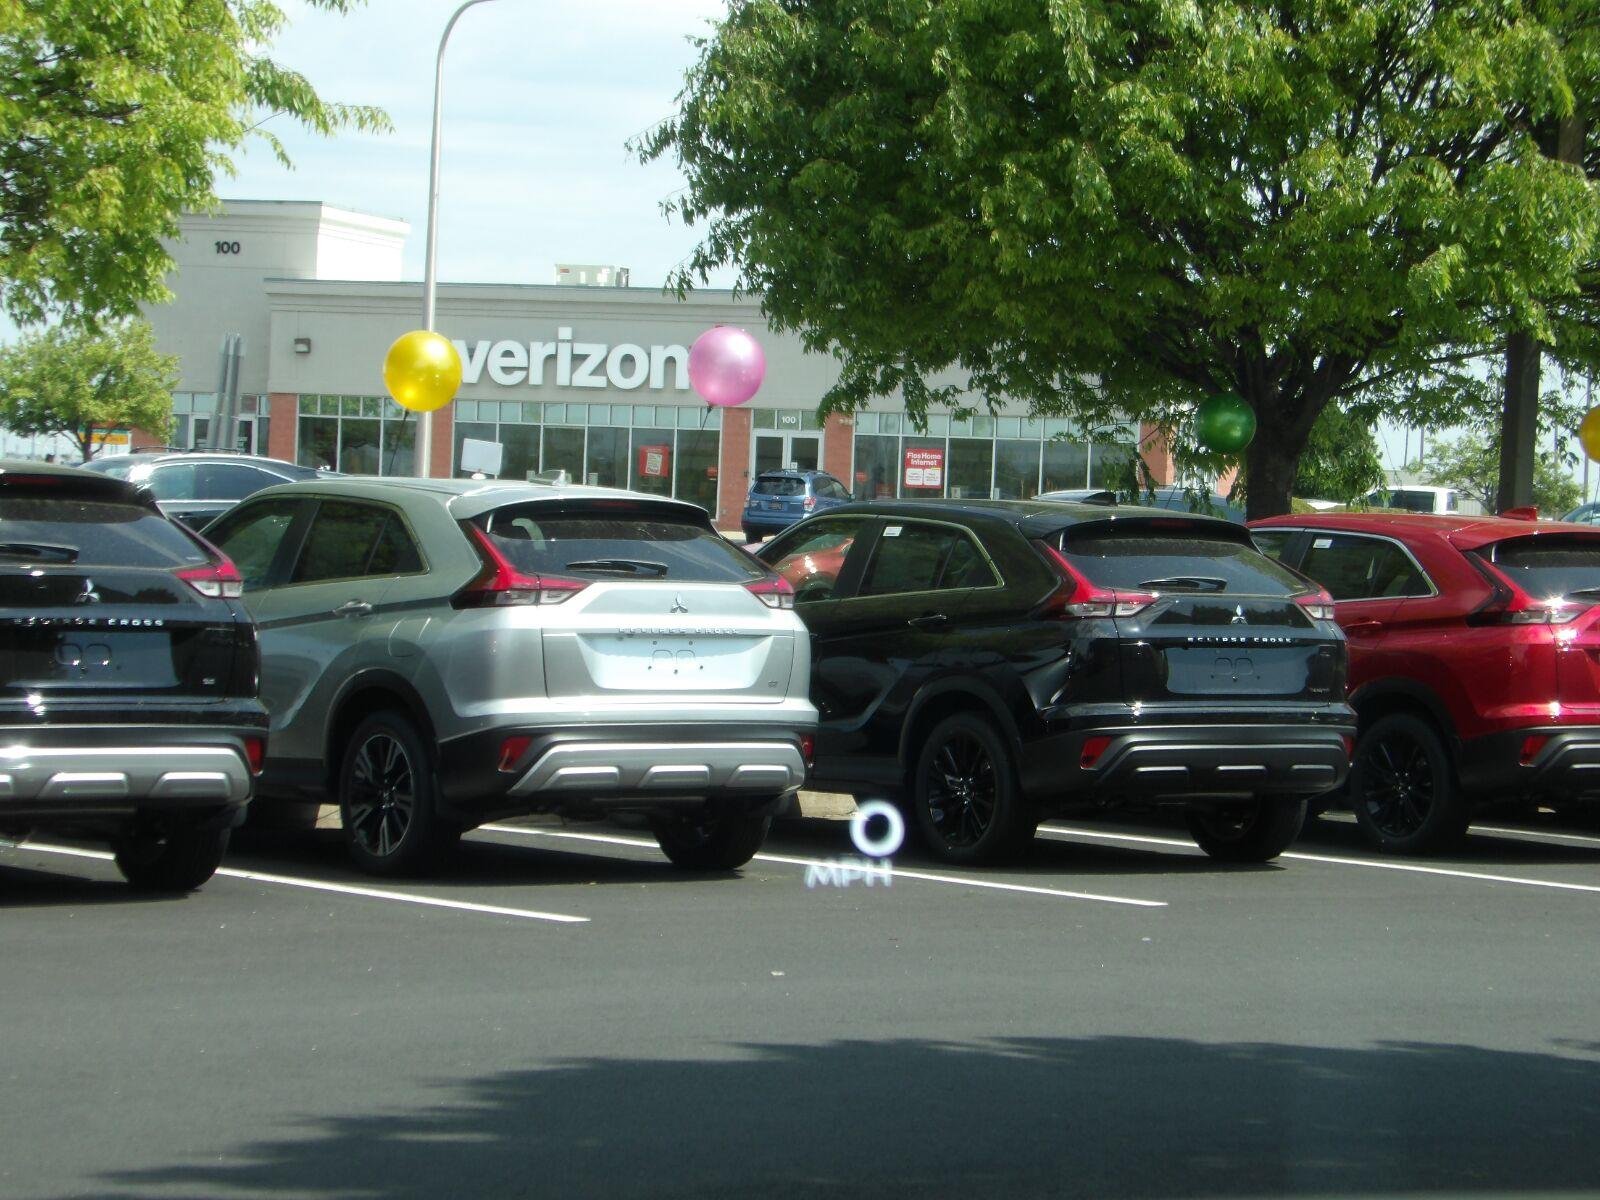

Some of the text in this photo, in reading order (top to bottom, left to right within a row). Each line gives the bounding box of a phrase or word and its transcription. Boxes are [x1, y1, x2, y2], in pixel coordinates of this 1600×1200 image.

[215, 241, 240, 254] 100
[452, 327, 690, 390] verizon
[782, 416, 796, 424] 100
[803, 858, 893, 888] MPH
